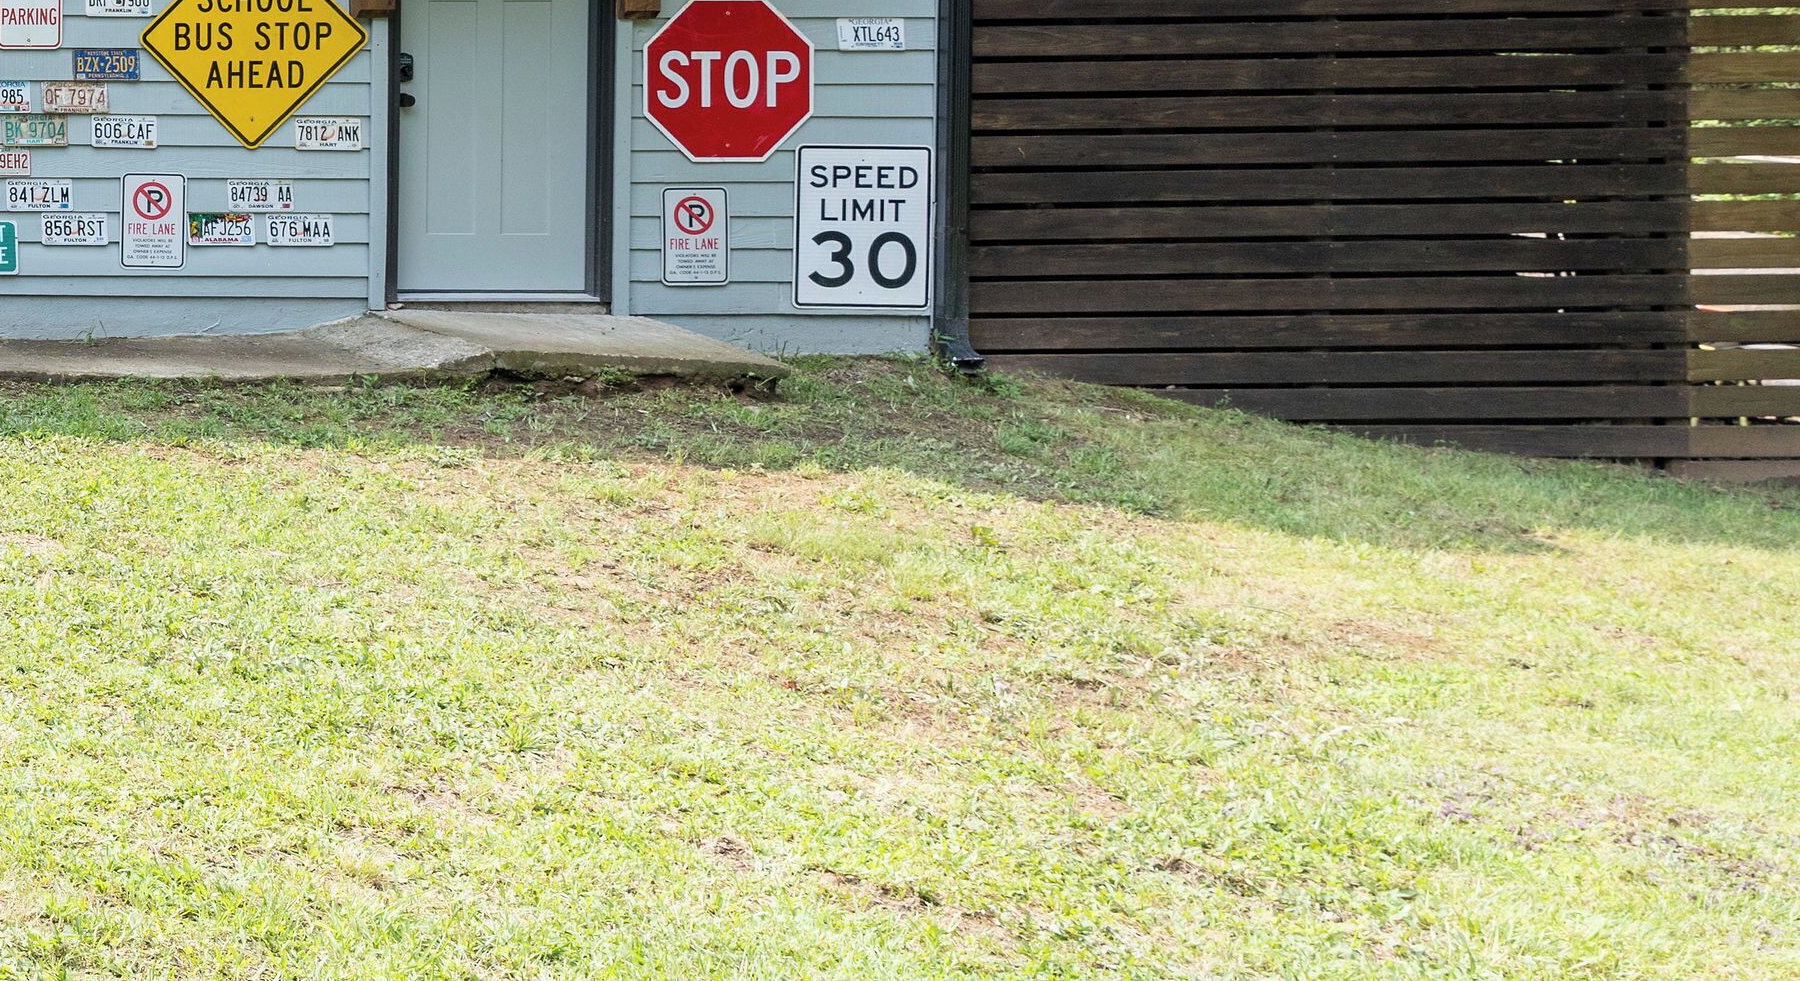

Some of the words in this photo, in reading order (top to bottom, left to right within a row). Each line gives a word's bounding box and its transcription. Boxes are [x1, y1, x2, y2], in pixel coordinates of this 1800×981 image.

[2, 8, 56, 26] PARKING
[174, 22, 232, 50] BUS
[255, 22, 332, 50] STOP
[853, 27, 900, 42] XTL643
[206, 60, 304, 88] AHEAD
[656, 51, 800, 108] STOP
[6, 121, 22, 137] BK
[30, 121, 65, 137] 9704
[298, 126, 326, 141] 7812
[338, 126, 359, 141] ANK
[810, 166, 918, 188] SPEED
[231, 187, 268, 202] 84739
[278, 187, 292, 202] AA
[820, 199, 906, 222] LIMIT
[128, 224, 147, 234] FIRE
[152, 224, 176, 235] LANE
[204, 222, 252, 236] AFJ256
[670, 238, 690, 250] FIRE
[696, 239, 719, 250] LANE
[808, 231, 917, 289] 30
